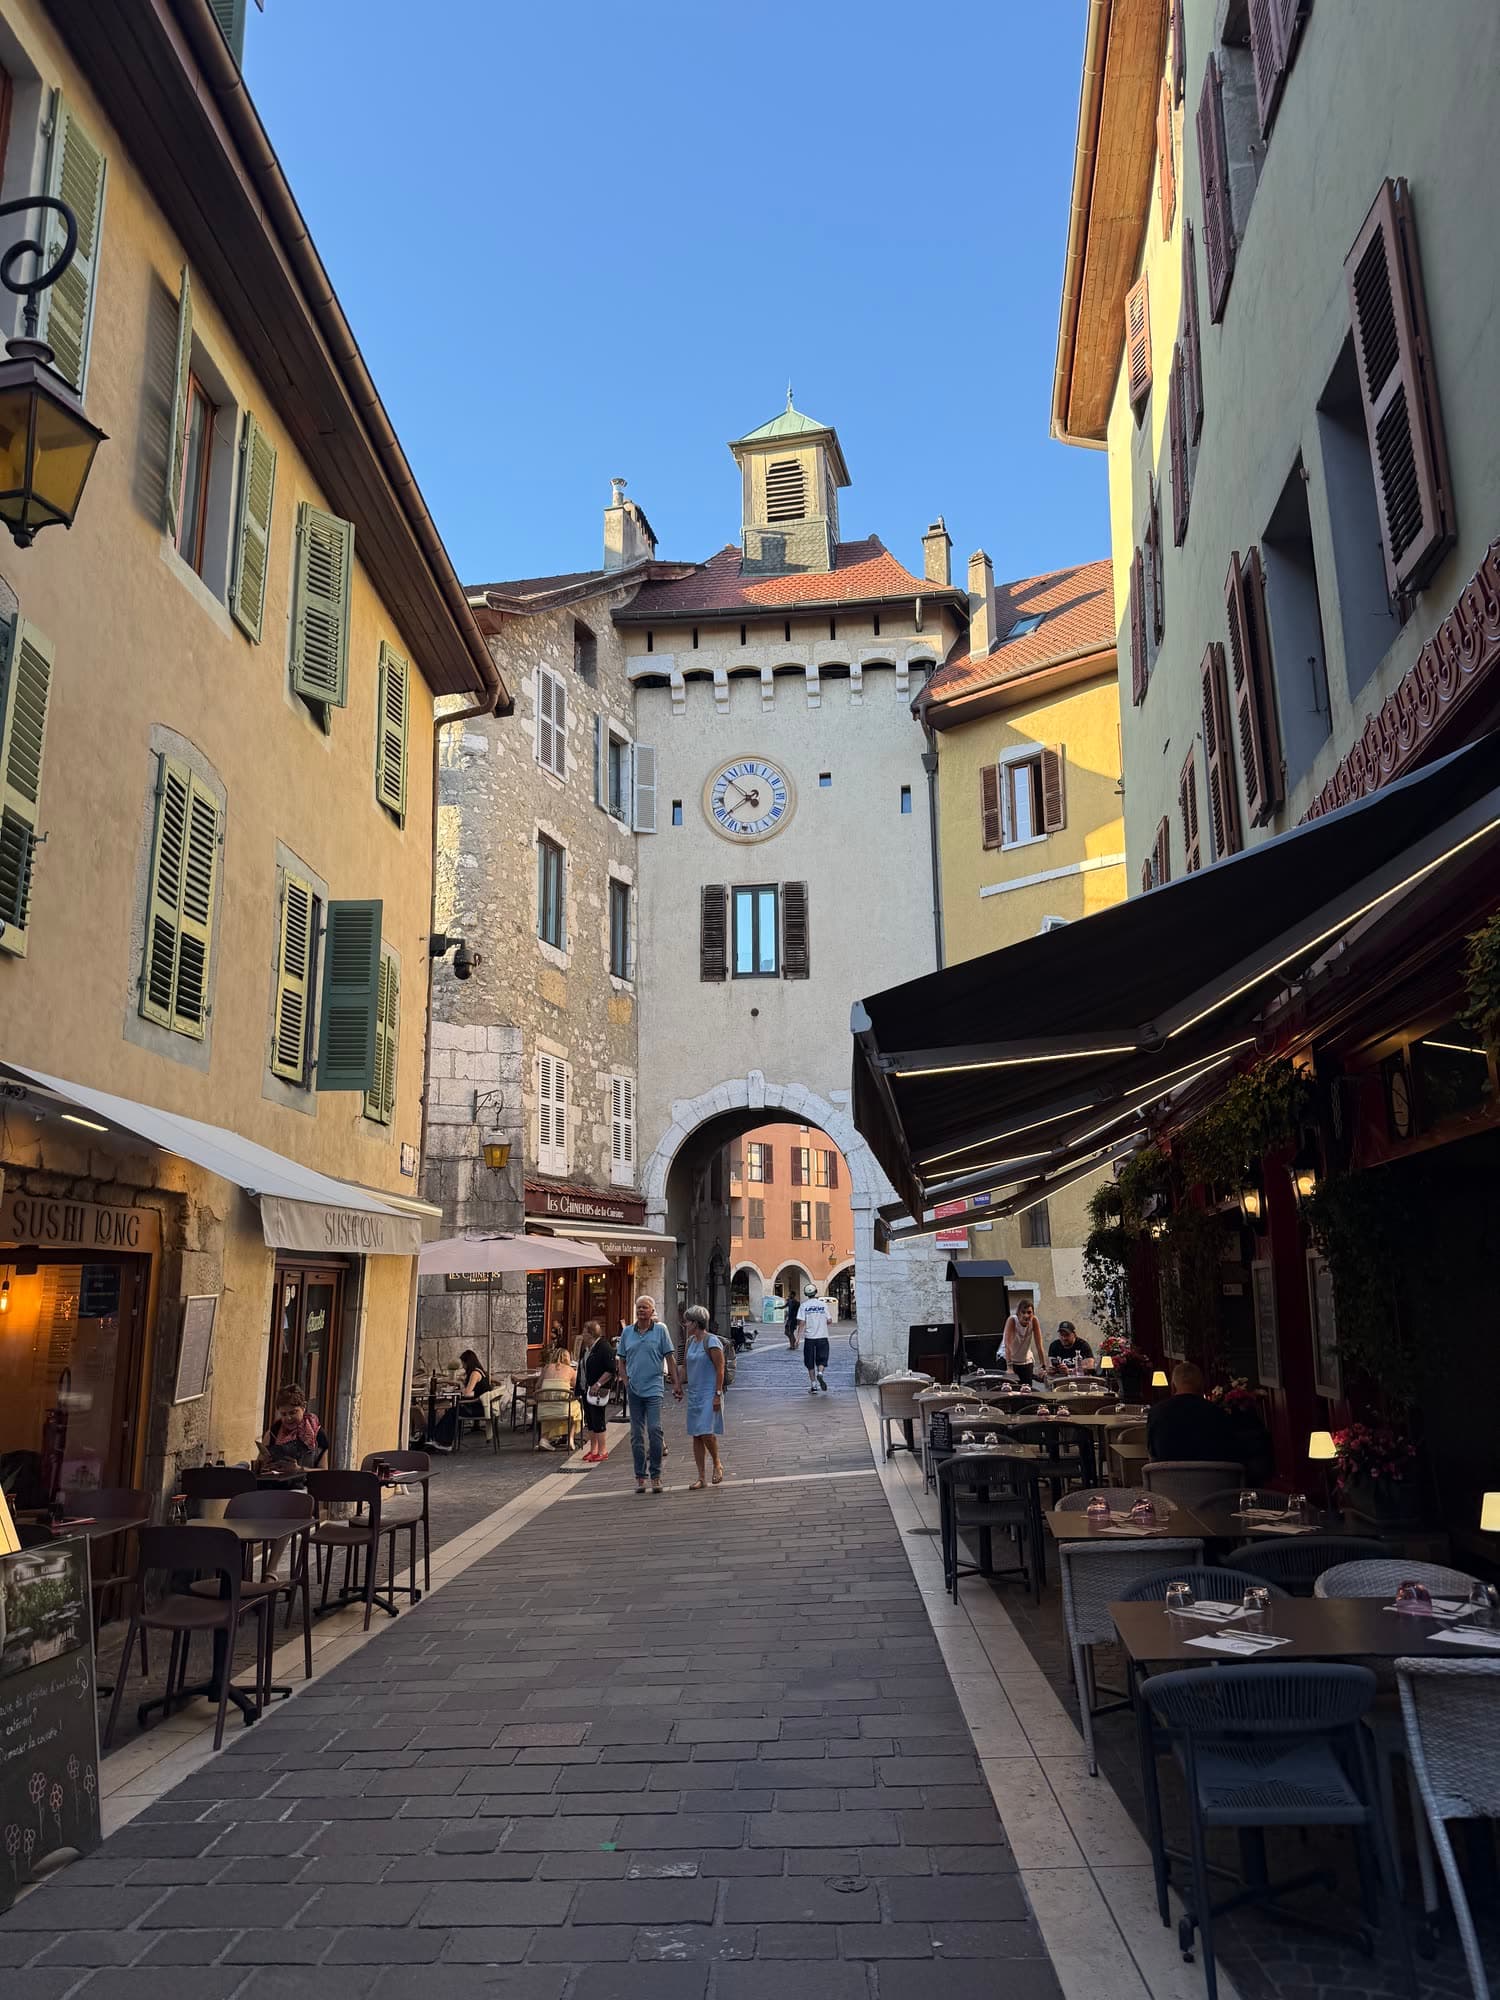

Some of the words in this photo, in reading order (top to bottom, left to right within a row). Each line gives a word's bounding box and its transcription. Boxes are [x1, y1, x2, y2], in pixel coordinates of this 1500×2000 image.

[13, 1200, 85, 1242] SUSHI
[547, 1193, 558, 1212] LES
[594, 1206, 601, 1216] de
[601, 1206, 606, 1217] la
[325, 1212, 358, 1247] SUSHI
